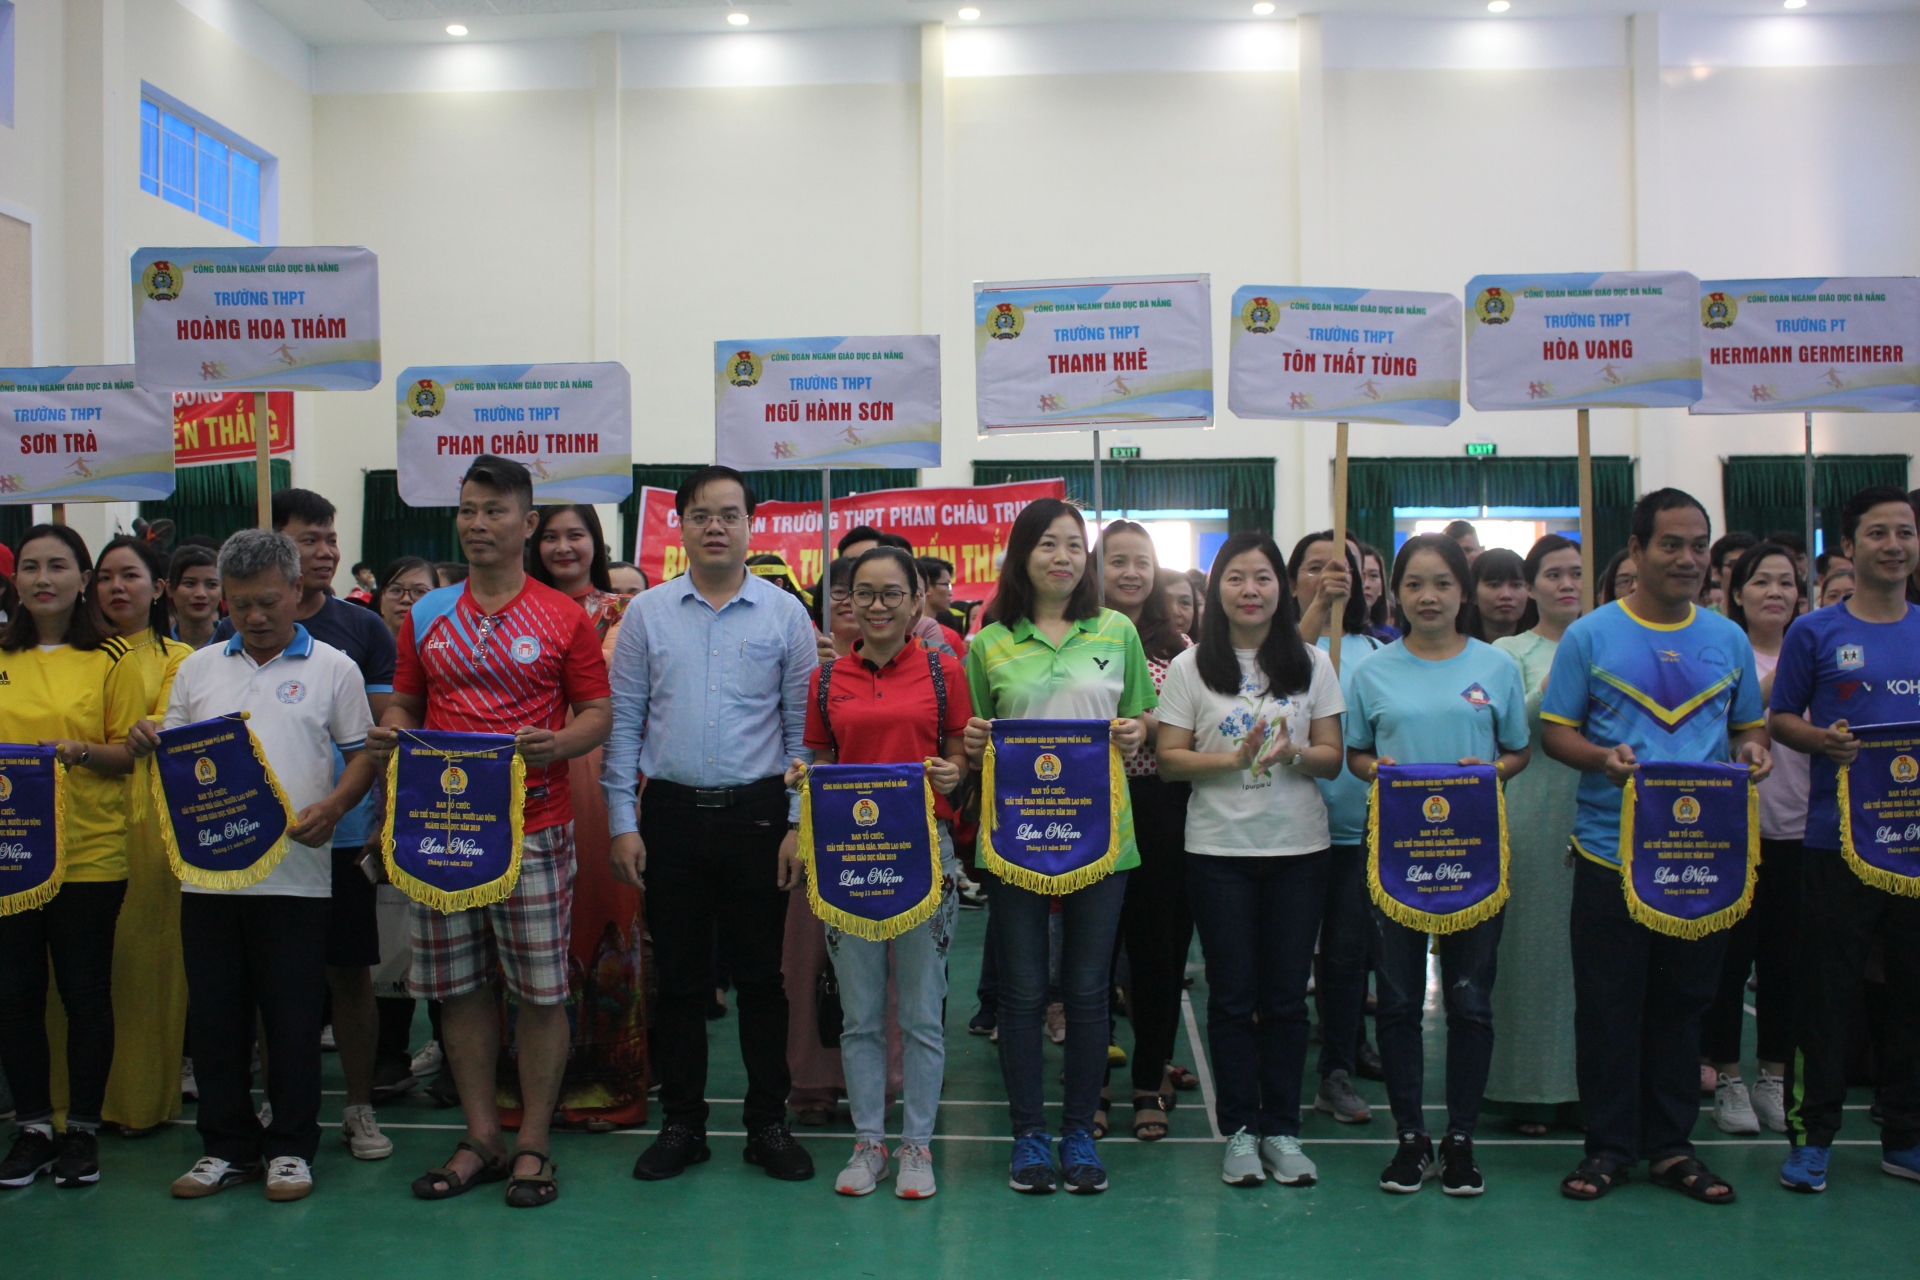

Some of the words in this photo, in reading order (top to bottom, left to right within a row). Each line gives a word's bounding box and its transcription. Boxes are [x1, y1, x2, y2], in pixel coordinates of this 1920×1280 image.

[193, 263, 214, 274] CÔNG
[239, 263, 265, 273] NGÀNH
[268, 263, 286, 273] GIÁO
[288, 264, 303, 275] DỤC
[214, 289, 268, 306] TRƯỜNG
[273, 291, 305, 305] THPT
[1524, 289, 1543, 298] CÔNG
[1568, 287, 1592, 297] NGÀNH
[1595, 287, 1611, 297] GIÁO
[1614, 288, 1628, 298] DỤC
[1747, 294, 1767, 303] CÔNG
[1792, 293, 1816, 302] NGÀNH
[1819, 292, 1835, 302] GIÁO
[1838, 294, 1851, 304] DỤC
[1034, 304, 1053, 313] CÔNG
[1077, 301, 1102, 311] NGÀNH
[1104, 300, 1121, 310] GIÁO
[1123, 301, 1137, 311] DỤC
[1290, 301, 1309, 311] CÔNG
[1334, 303, 1358, 312] NGÀNH
[1361, 303, 1377, 313] GIÁO
[1379, 305, 1392, 315] DỤC
[177, 316, 240, 340] HOÀNG
[248, 319, 285, 339] HOA
[292, 314, 346, 338] THÁM
[1544, 311, 1595, 328] TRƯỜNG
[1599, 313, 1631, 327] THPT
[1776, 316, 1826, 332] TRƯỜNG
[1831, 319, 1846, 332] PT
[1054, 324, 1105, 342] TRƯỜNG
[1109, 326, 1140, 339] THPT
[1309, 325, 1359, 342] TRƯỜNG
[1364, 330, 1394, 344] THPT
[772, 353, 790, 362] CÔNG
[812, 351, 836, 361] NGÀNH
[838, 351, 854, 360] GIÁO
[857, 353, 870, 362] DỤC
[1543, 337, 1579, 360] HÒA
[1585, 340, 1632, 359] VANG
[1711, 346, 1792, 364] HERMANN
[1799, 346, 1903, 362] GERMEINERR
[1048, 353, 1106, 374] THANH
[1114, 348, 1147, 371] KHÊ
[1283, 349, 1316, 372] TÔN
[1323, 348, 1366, 374] THẤT
[1372, 353, 1416, 377] TÙNG
[0, 384, 15, 392] ÔNG
[40, 383, 65, 391] NGÀNH
[67, 382, 84, 391] GIÁO
[86, 382, 100, 392] DỤC
[455, 382, 474, 391] CÔNG
[498, 379, 523, 390] NGÀNH
[525, 379, 542, 389] GIÁO
[544, 381, 558, 391] DỤC
[790, 374, 838, 391] TRƯỜNG
[842, 377, 871, 390] THPT
[14, 406, 66, 422] TRƯỜNG
[71, 407, 102, 420] THPT
[474, 404, 524, 422] TRƯỜNG
[529, 407, 560, 421] THPT
[766, 400, 799, 422] NGŨ
[806, 399, 850, 421] HÀNH
[859, 401, 893, 420] SƠN
[21, 433, 57, 454] SƠN
[63, 429, 97, 453] TRÀ
[437, 436, 484, 455] PHAN
[491, 431, 539, 454] CHÂU
[545, 433, 598, 453] TRINH
[1468, 444, 1494, 455] EXIT
[1113, 448, 1137, 458] EXIT
[844, 508, 885, 529] THPT
[890, 506, 936, 527] PHAN
[941, 499, 988, 526] CHÂU
[1887, 680, 1920, 695] KOH
